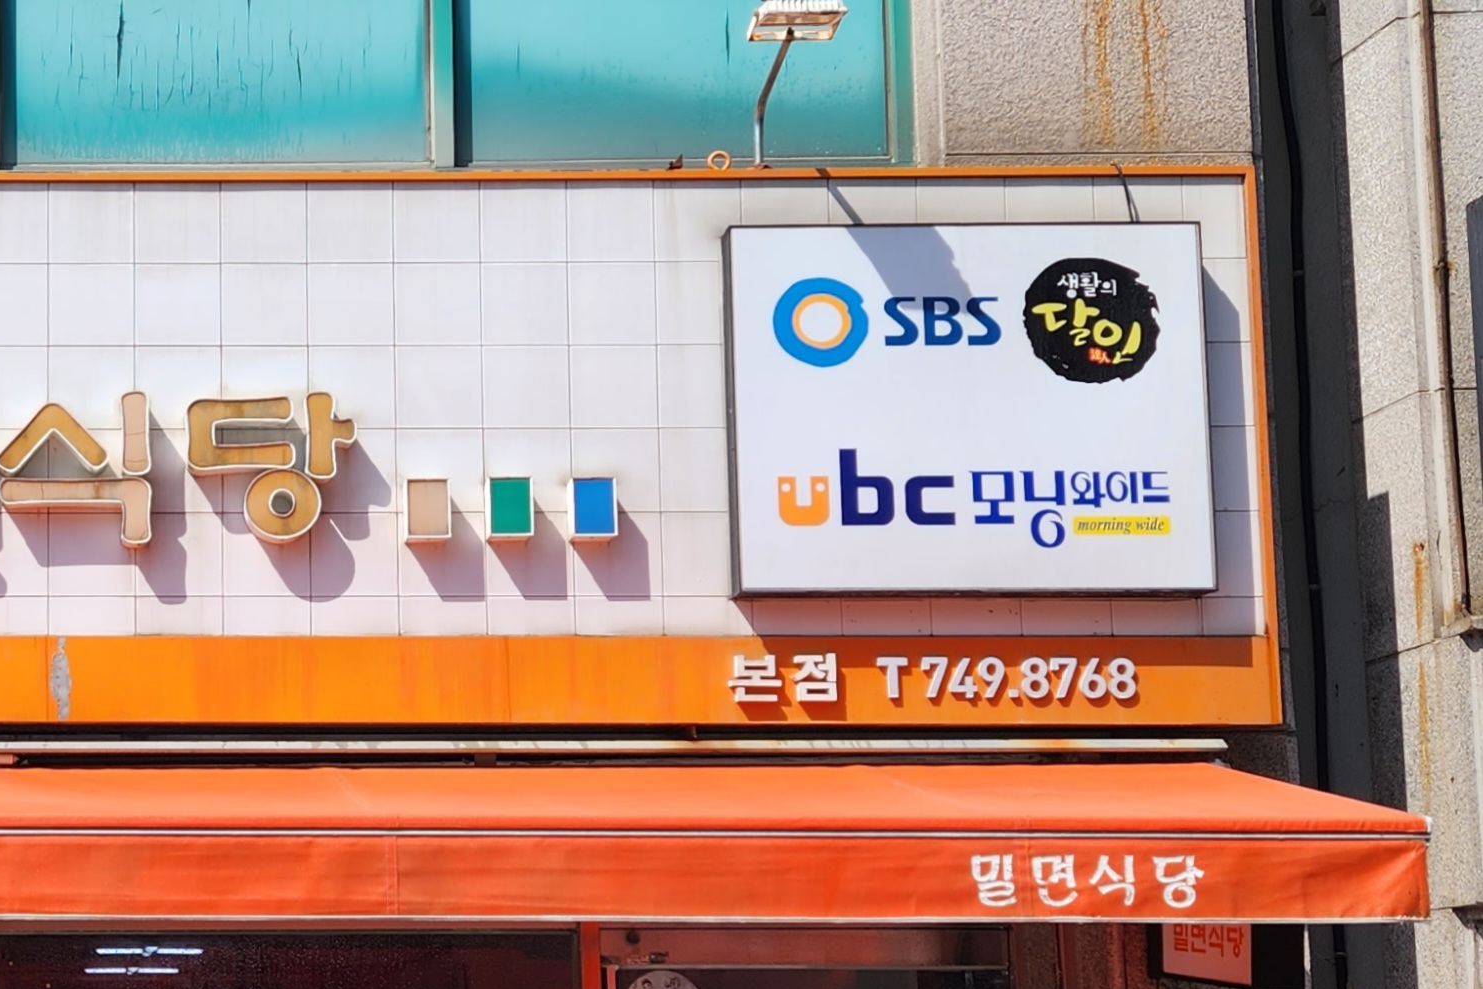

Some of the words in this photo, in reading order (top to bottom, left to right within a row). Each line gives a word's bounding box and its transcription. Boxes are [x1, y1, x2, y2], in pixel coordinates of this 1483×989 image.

[1057, 271, 1117, 299] 생활의
[883, 296, 1002, 346] SBS
[1031, 298, 1141, 364] 달인
[778, 447, 956, 526] ubc
[1077, 517, 1131, 534] morning
[1135, 517, 1165, 531] wide
[728, 653, 838, 703] 본점
[970, 853, 1206, 909] 밀면식당
[1173, 923, 1244, 958] 밀면식당
